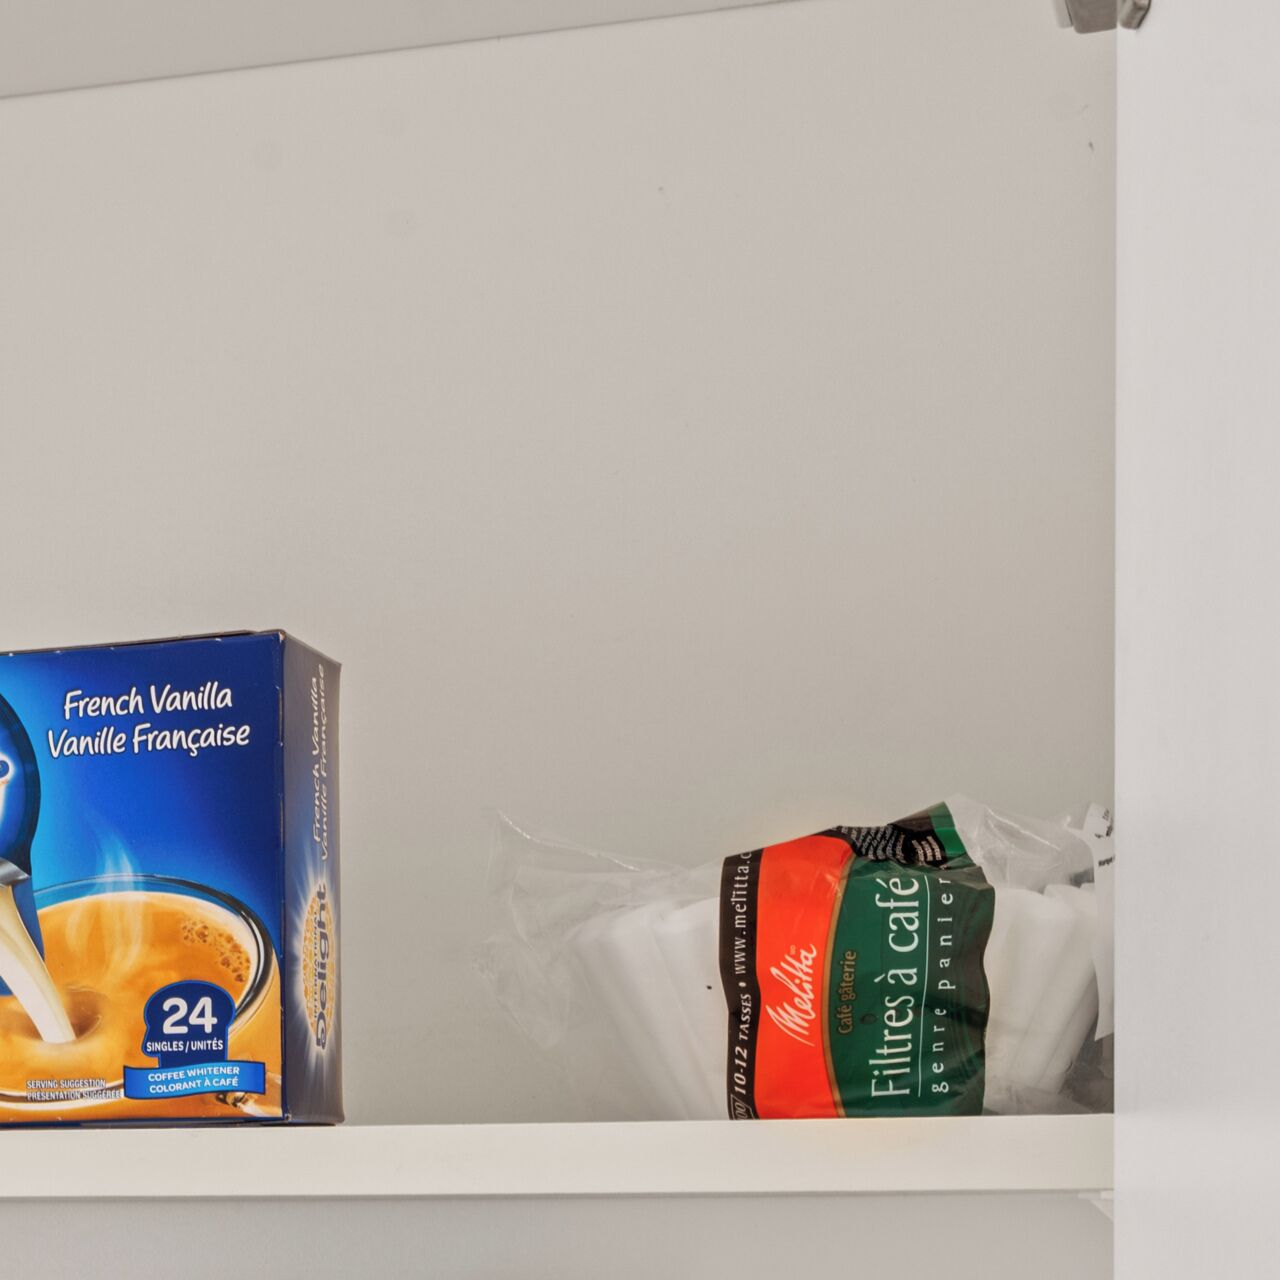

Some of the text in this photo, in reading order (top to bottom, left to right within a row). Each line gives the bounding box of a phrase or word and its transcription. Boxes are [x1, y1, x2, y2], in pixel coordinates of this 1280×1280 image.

[63, 681, 233, 720] French Vanilla
[311, 677, 320, 756] Vanilla
[48, 722, 251, 759] Vanille Française
[317, 883, 329, 1050] Delight
[868, 877, 920, 1098] Filtres à café
[931, 877, 956, 1094] genre panier
[765, 943, 817, 1046] Melitta
[837, 950, 857, 1034] Café gâterie
[162, 996, 218, 1035] 24
[739, 994, 751, 1040] TASSES
[146, 1040, 184, 1052] SINGLES
[191, 1037, 224, 1051] UNITÉS
[26, 1079, 107, 1089] SERVING SUGGESTION
[148, 1065, 241, 1082] COFFEE WHITENER
[149, 1076, 239, 1094] COLORANT À CAFÉ
[734, 1046, 747, 1094] 10-12
